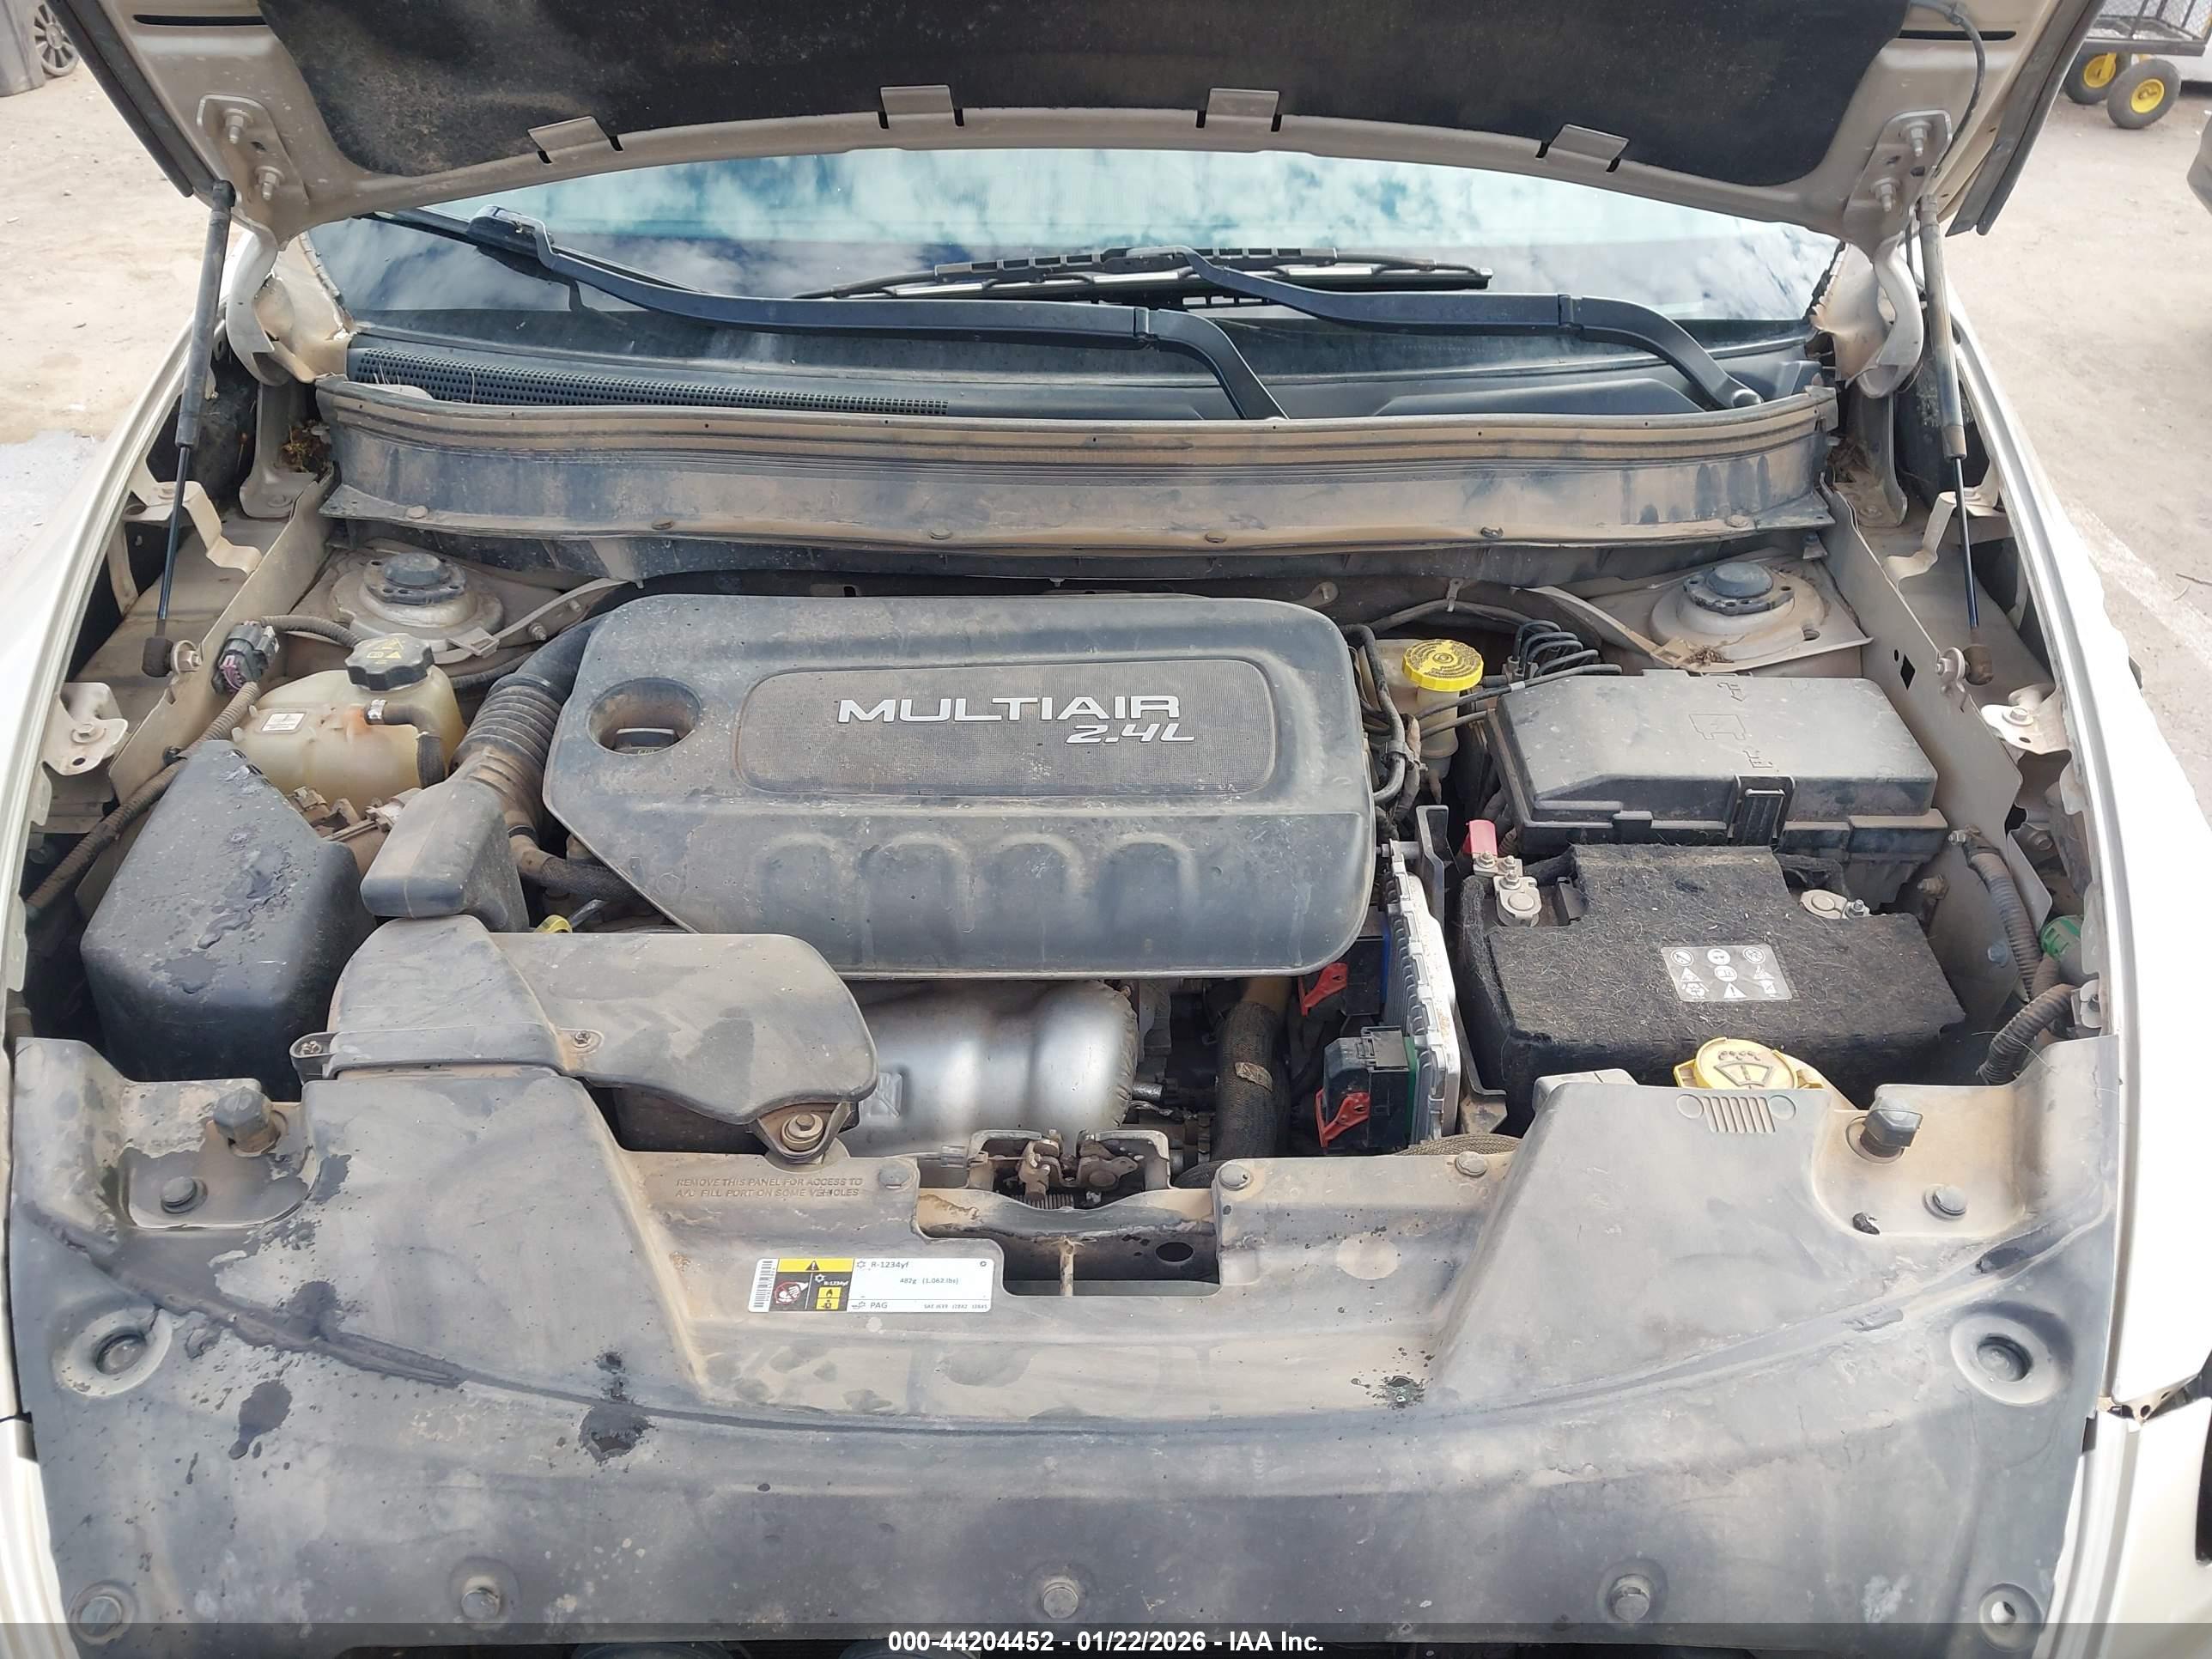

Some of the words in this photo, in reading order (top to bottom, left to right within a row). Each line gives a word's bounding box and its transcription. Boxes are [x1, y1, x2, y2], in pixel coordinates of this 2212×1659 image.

[838, 696, 1180, 722] MULTIAIR
[1065, 723, 1195, 744] 2.4L
[676, 1178, 720, 1187] REMOVE
[721, 1178, 745, 1187] THIS
[748, 1178, 781, 1187] PANEL
[783, 1178, 804, 1187] FOR
[806, 1177, 846, 1186] ACCESS
[848, 1177, 864, 1186] TO
[775, 1188, 805, 1197] SOME
